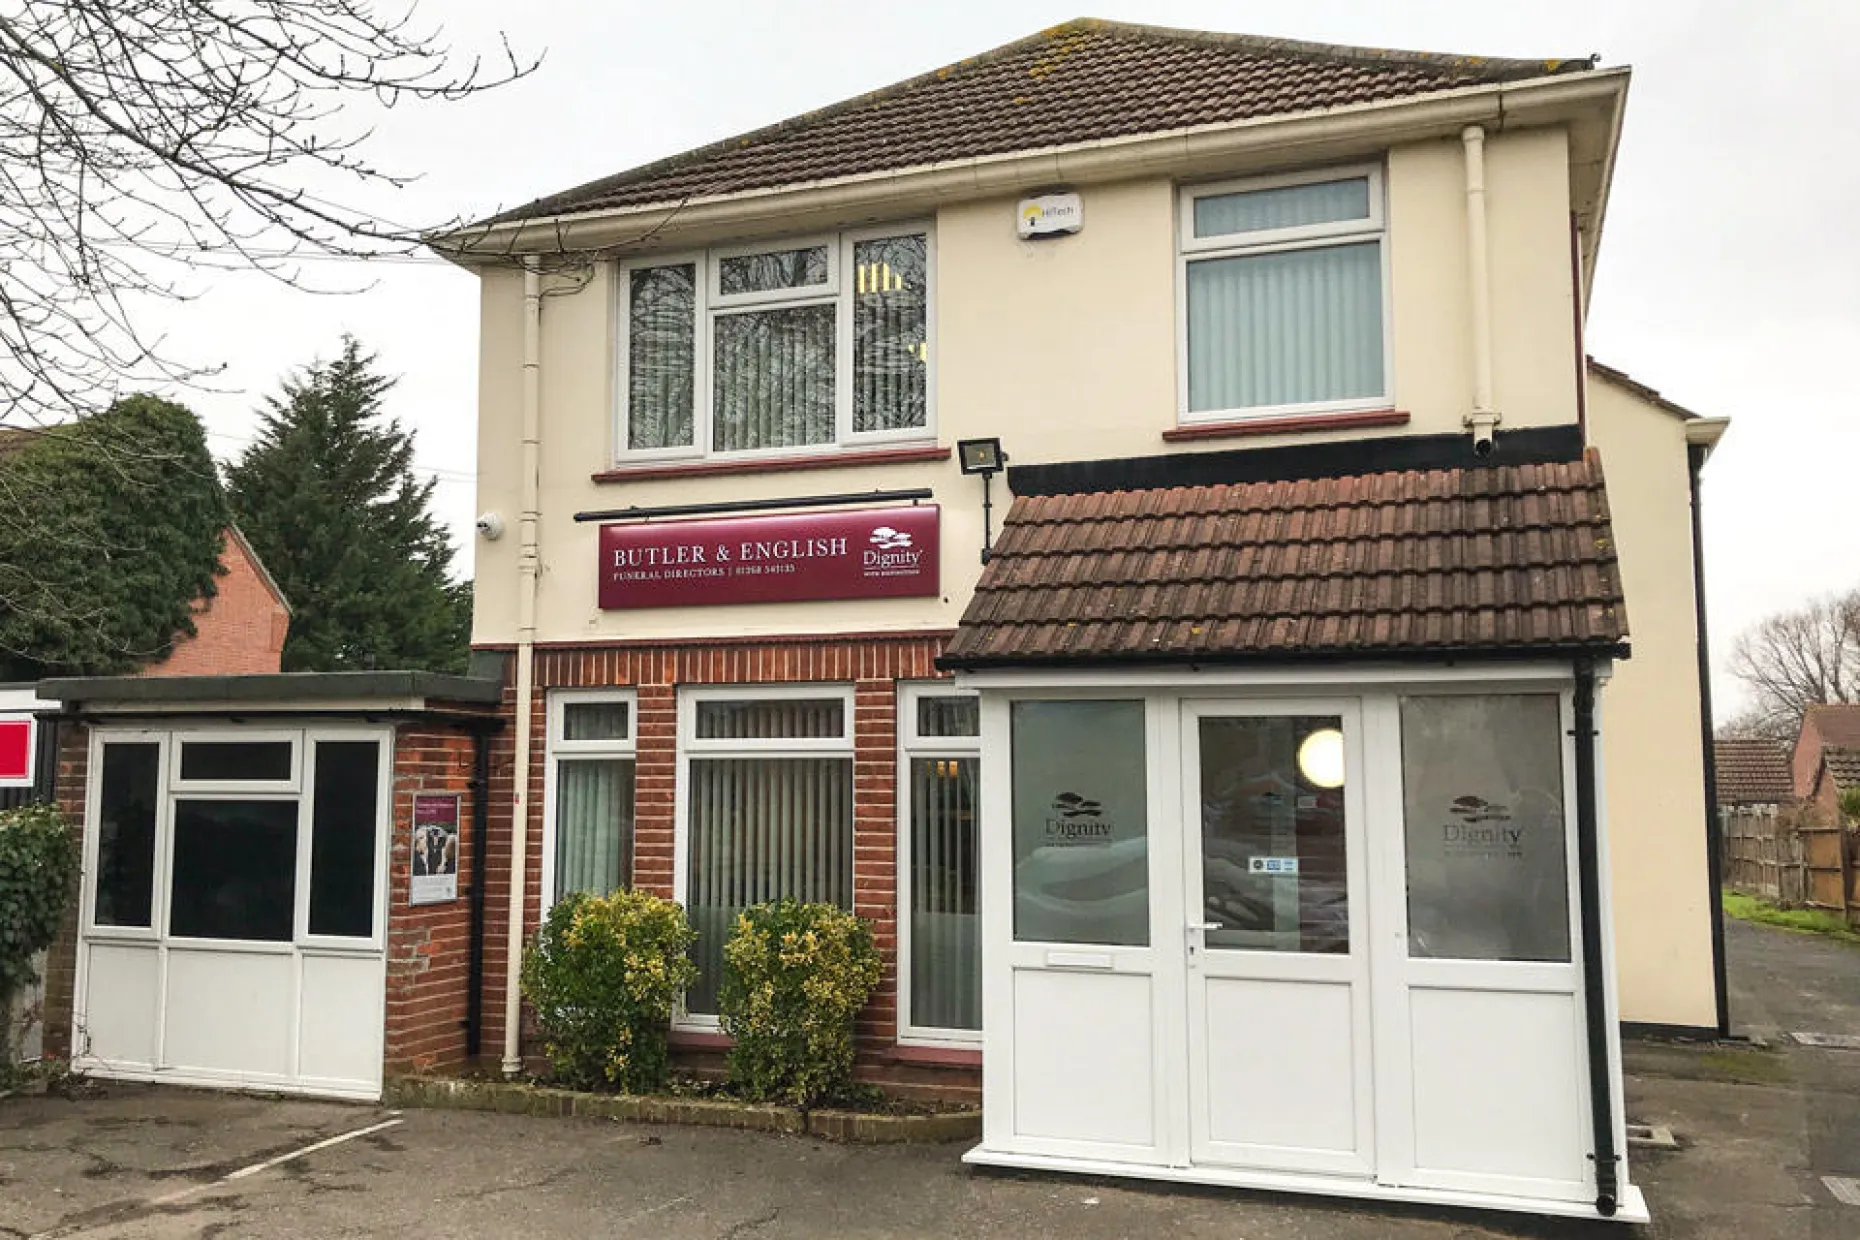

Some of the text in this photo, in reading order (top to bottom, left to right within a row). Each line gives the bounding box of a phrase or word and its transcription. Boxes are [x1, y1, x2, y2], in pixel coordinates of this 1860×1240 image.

[614, 537, 848, 567] BUTLER & ENGLISH
[863, 549, 920, 569] Dignity
[613, 570, 661, 582] FUNERAL
[664, 567, 724, 579] DIRECTORS
[1045, 818, 1112, 839] Dignity
[1442, 824, 1523, 848] Dignity
